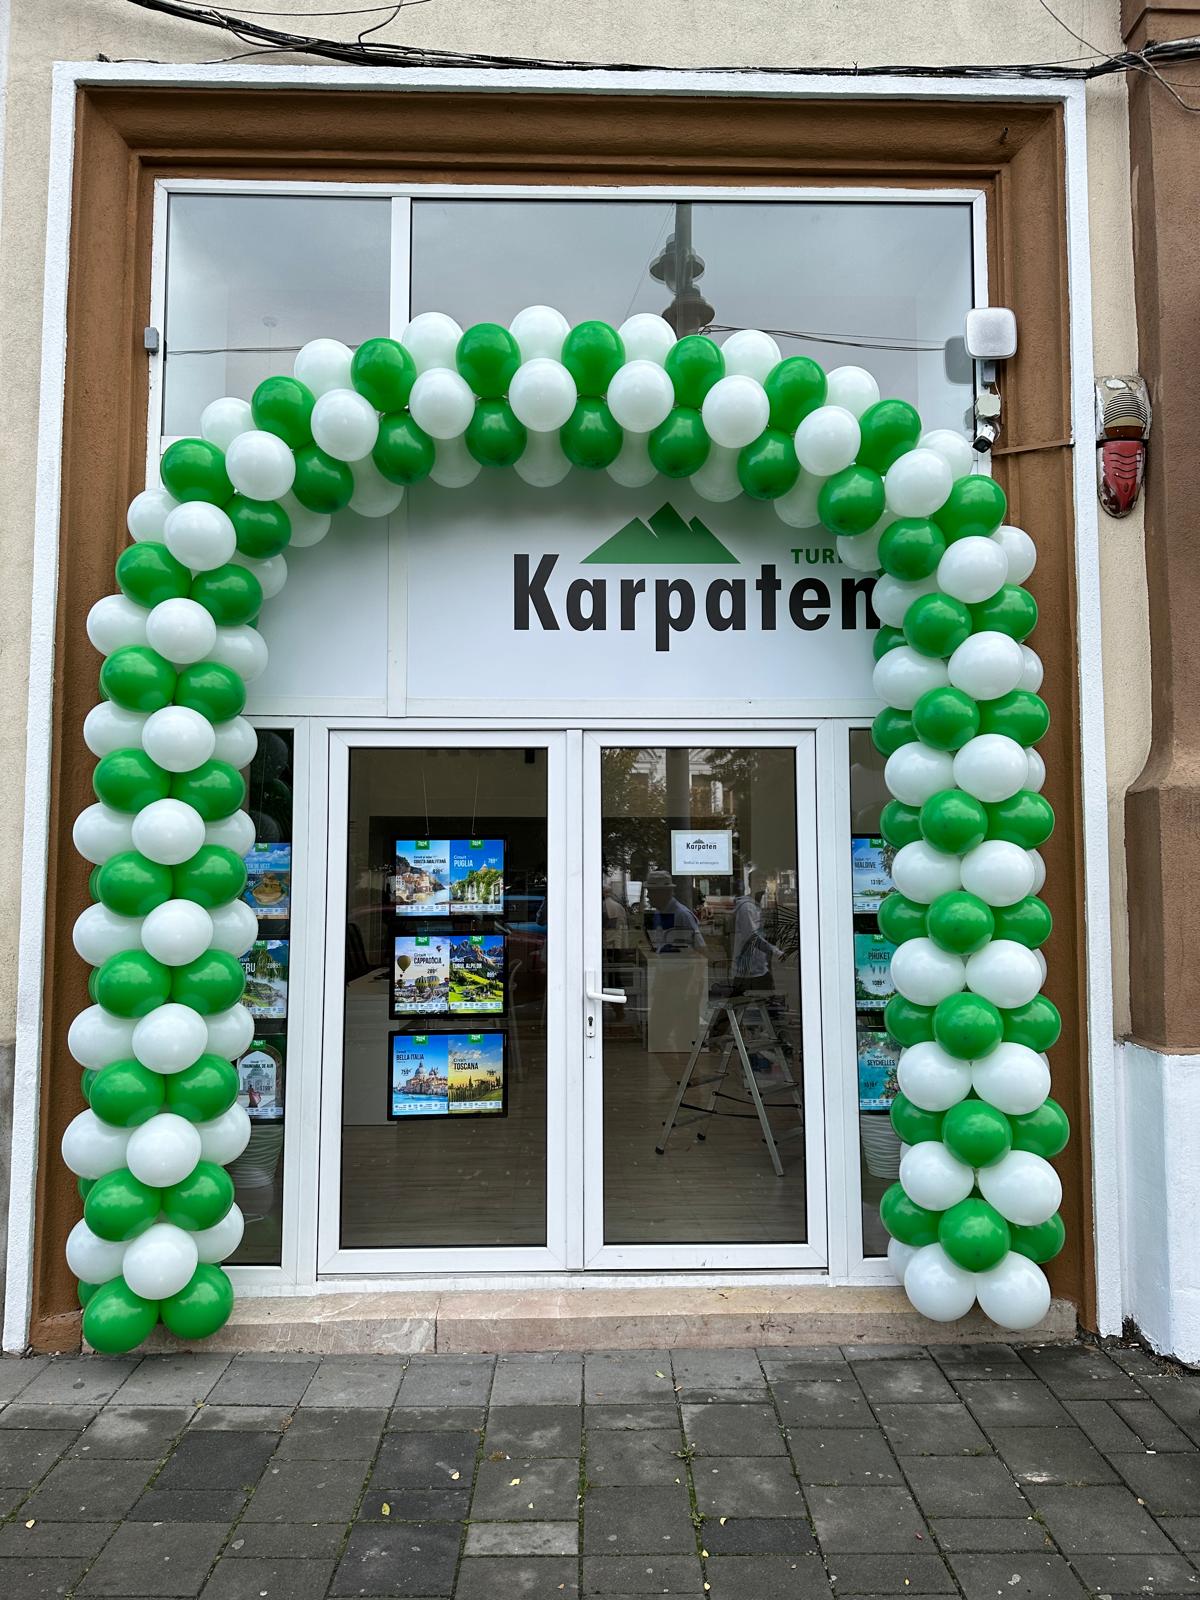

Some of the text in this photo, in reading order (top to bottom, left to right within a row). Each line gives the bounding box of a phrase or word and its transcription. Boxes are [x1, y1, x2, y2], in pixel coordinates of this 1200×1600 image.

[791, 548, 844, 564] TUR
[513, 553, 881, 652] Karpaten
[686, 842, 717, 851] Karpaten
[453, 859, 474, 868] PUGLIA
[854, 861, 876, 869] MALDIVE
[868, 951, 890, 960] PHUKET
[241, 962, 256, 973] ERU
[453, 1062, 479, 1071] TOSCANA
